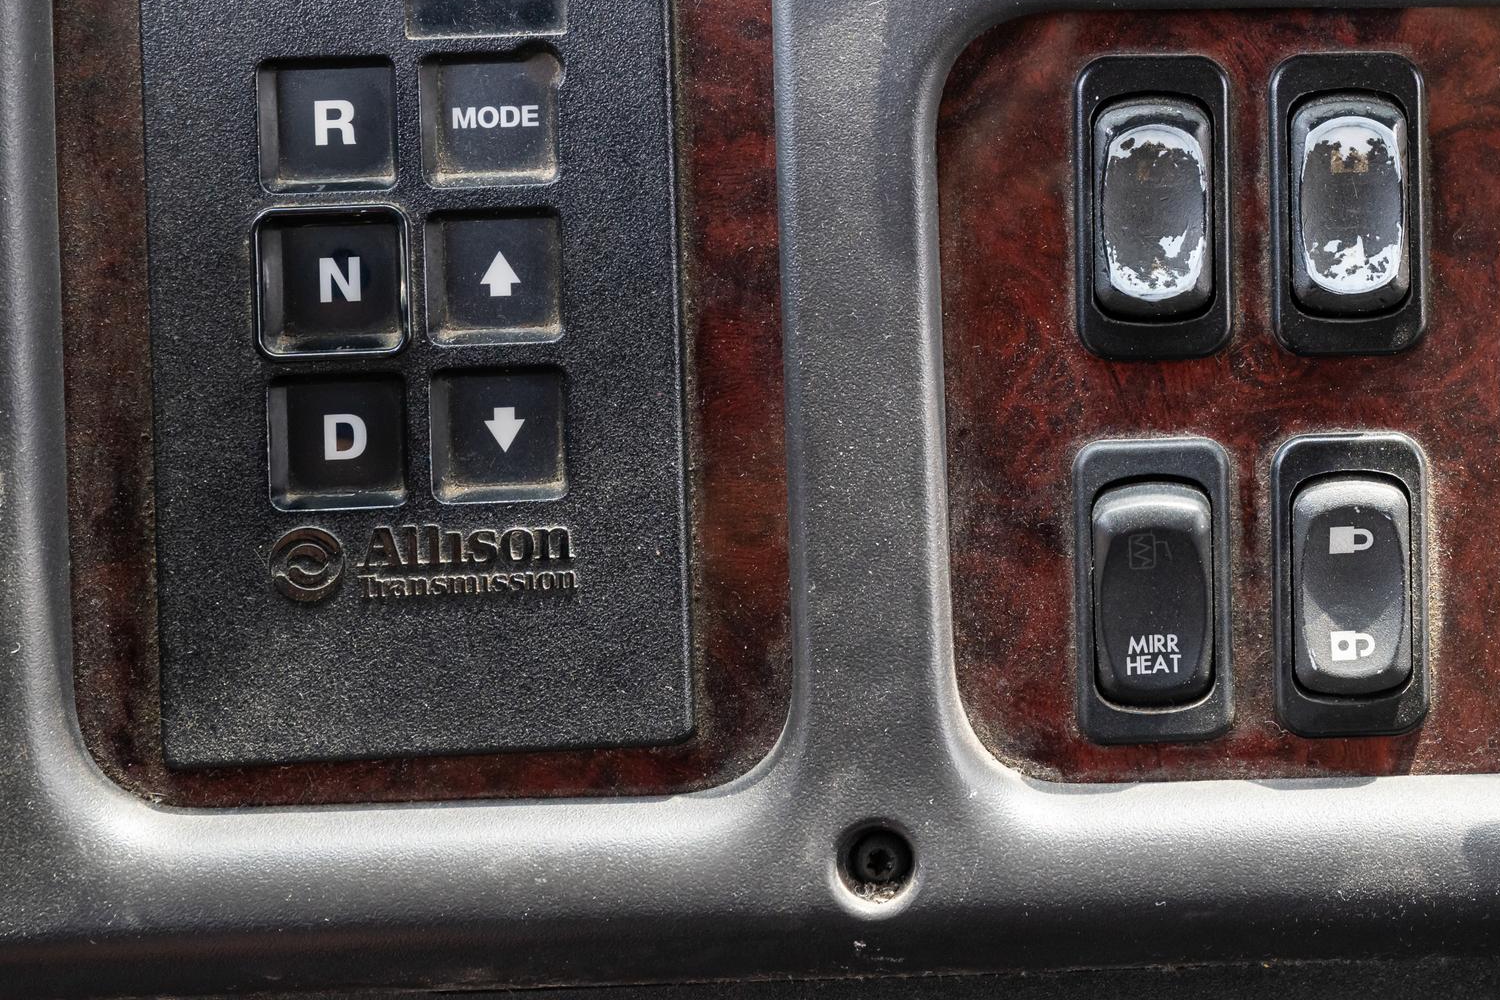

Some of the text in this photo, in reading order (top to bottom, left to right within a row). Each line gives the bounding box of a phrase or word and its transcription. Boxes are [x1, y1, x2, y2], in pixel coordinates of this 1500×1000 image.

[313, 100, 356, 146] R
[451, 104, 540, 130] MODE
[318, 256, 362, 303] N
[323, 413, 368, 461] D
[357, 524, 576, 568] Allison
[358, 568, 579, 599] Transmission
[1127, 633, 1179, 655] MIRR
[1126, 655, 1182, 676] HEAT
